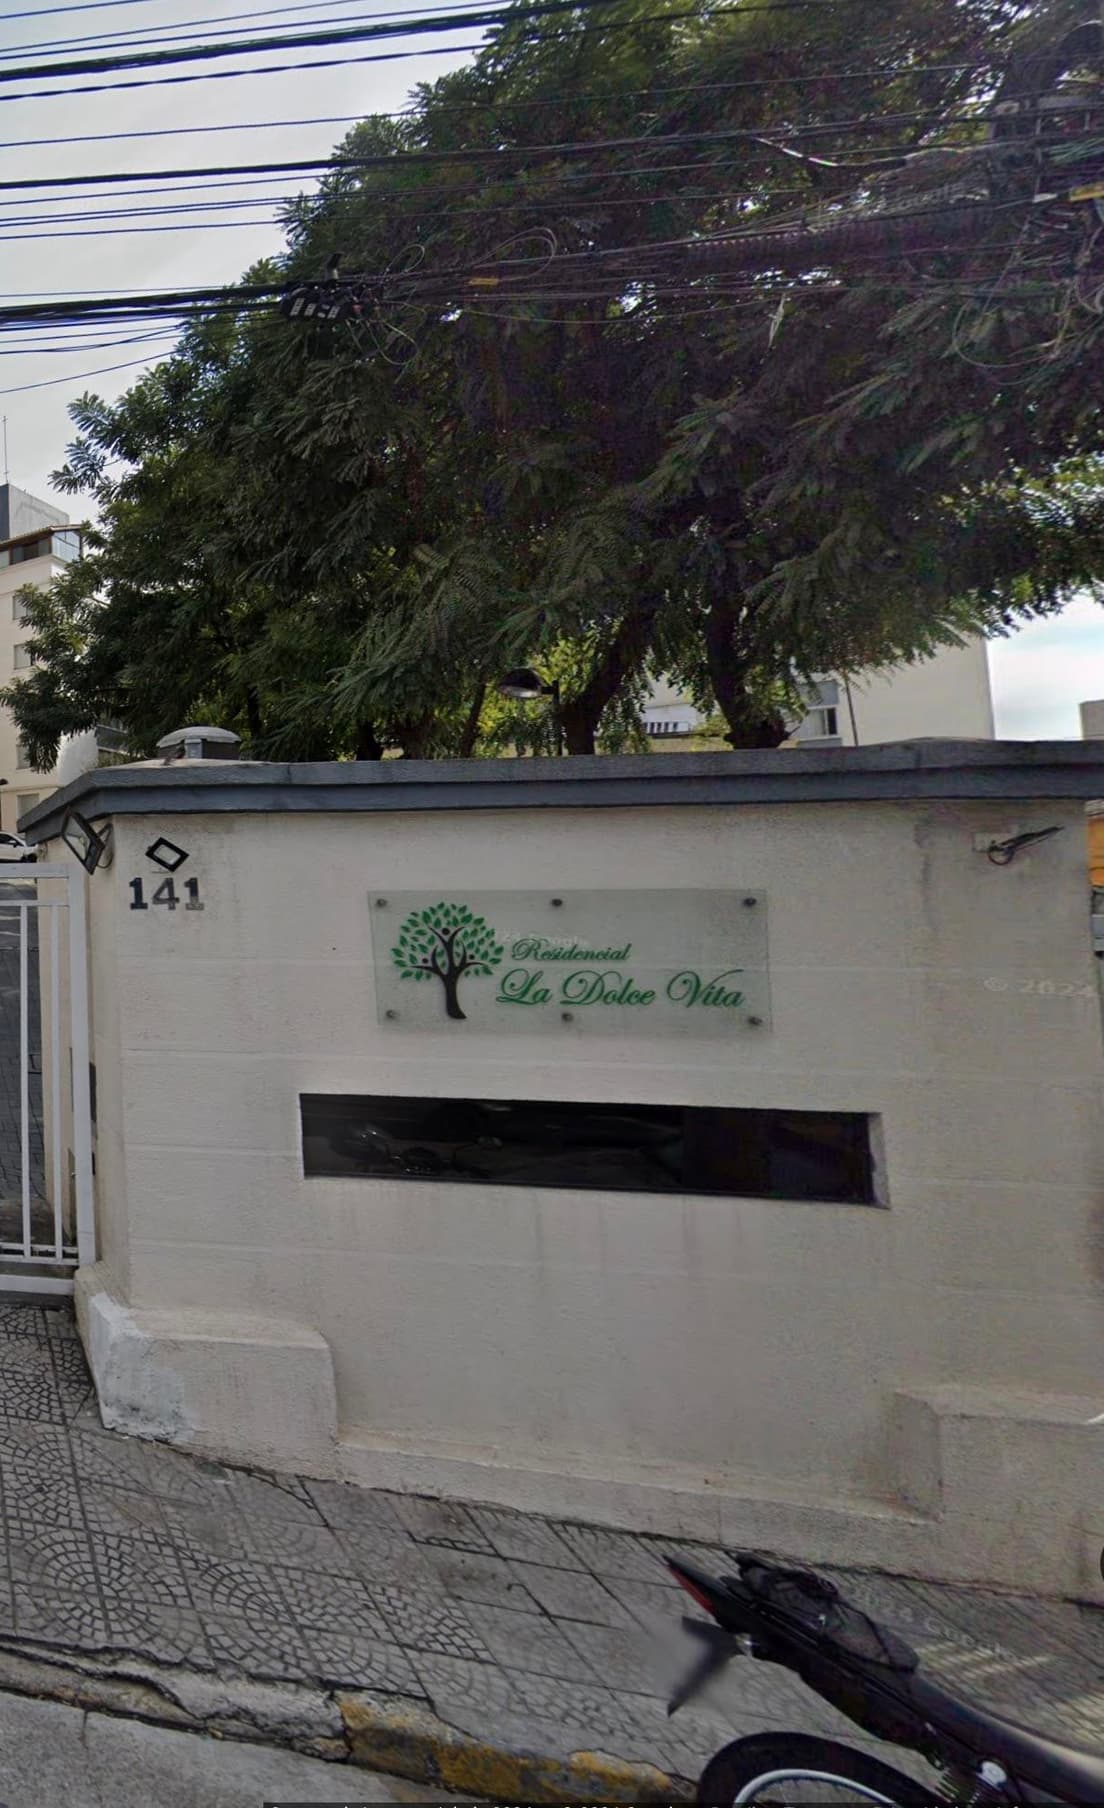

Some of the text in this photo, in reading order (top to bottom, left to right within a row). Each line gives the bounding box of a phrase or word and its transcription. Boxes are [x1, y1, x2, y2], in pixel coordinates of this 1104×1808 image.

[129, 877, 205, 911] 141
[511, 937, 632, 961] Residencial
[496, 968, 744, 1008] La Dolce Vita
